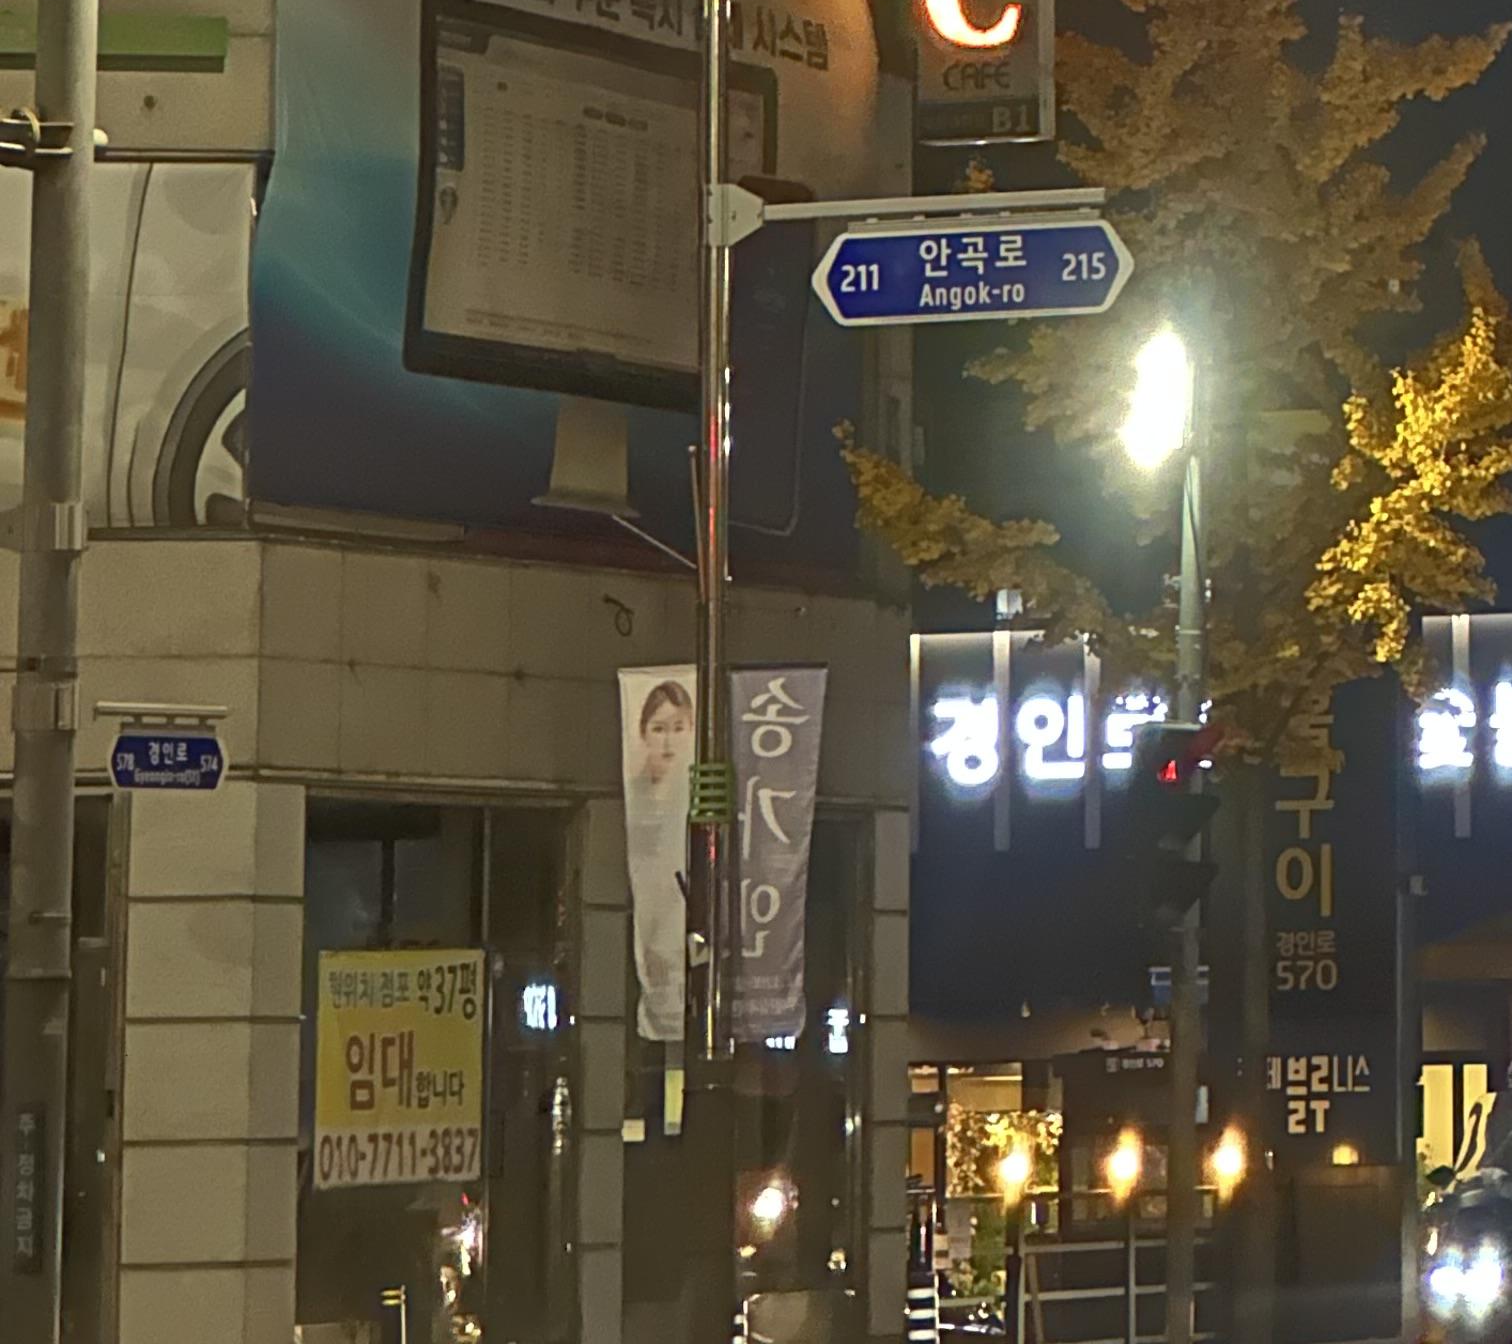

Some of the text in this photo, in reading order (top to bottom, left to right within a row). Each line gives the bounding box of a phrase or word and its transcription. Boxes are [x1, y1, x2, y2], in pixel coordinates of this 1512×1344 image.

[752, 5, 829, 72] 시스템
[919, 234, 1027, 277] 안곡로
[1062, 252, 1106, 281] 215
[840, 265, 880, 292] 211
[919, 282, 1025, 310] Angok-ro
[148, 742, 188, 766] 경인로
[1276, 930, 1337, 957] 경인로
[1276, 959, 1338, 991] 570
[319, 1127, 479, 1183] 010-7711-3837
